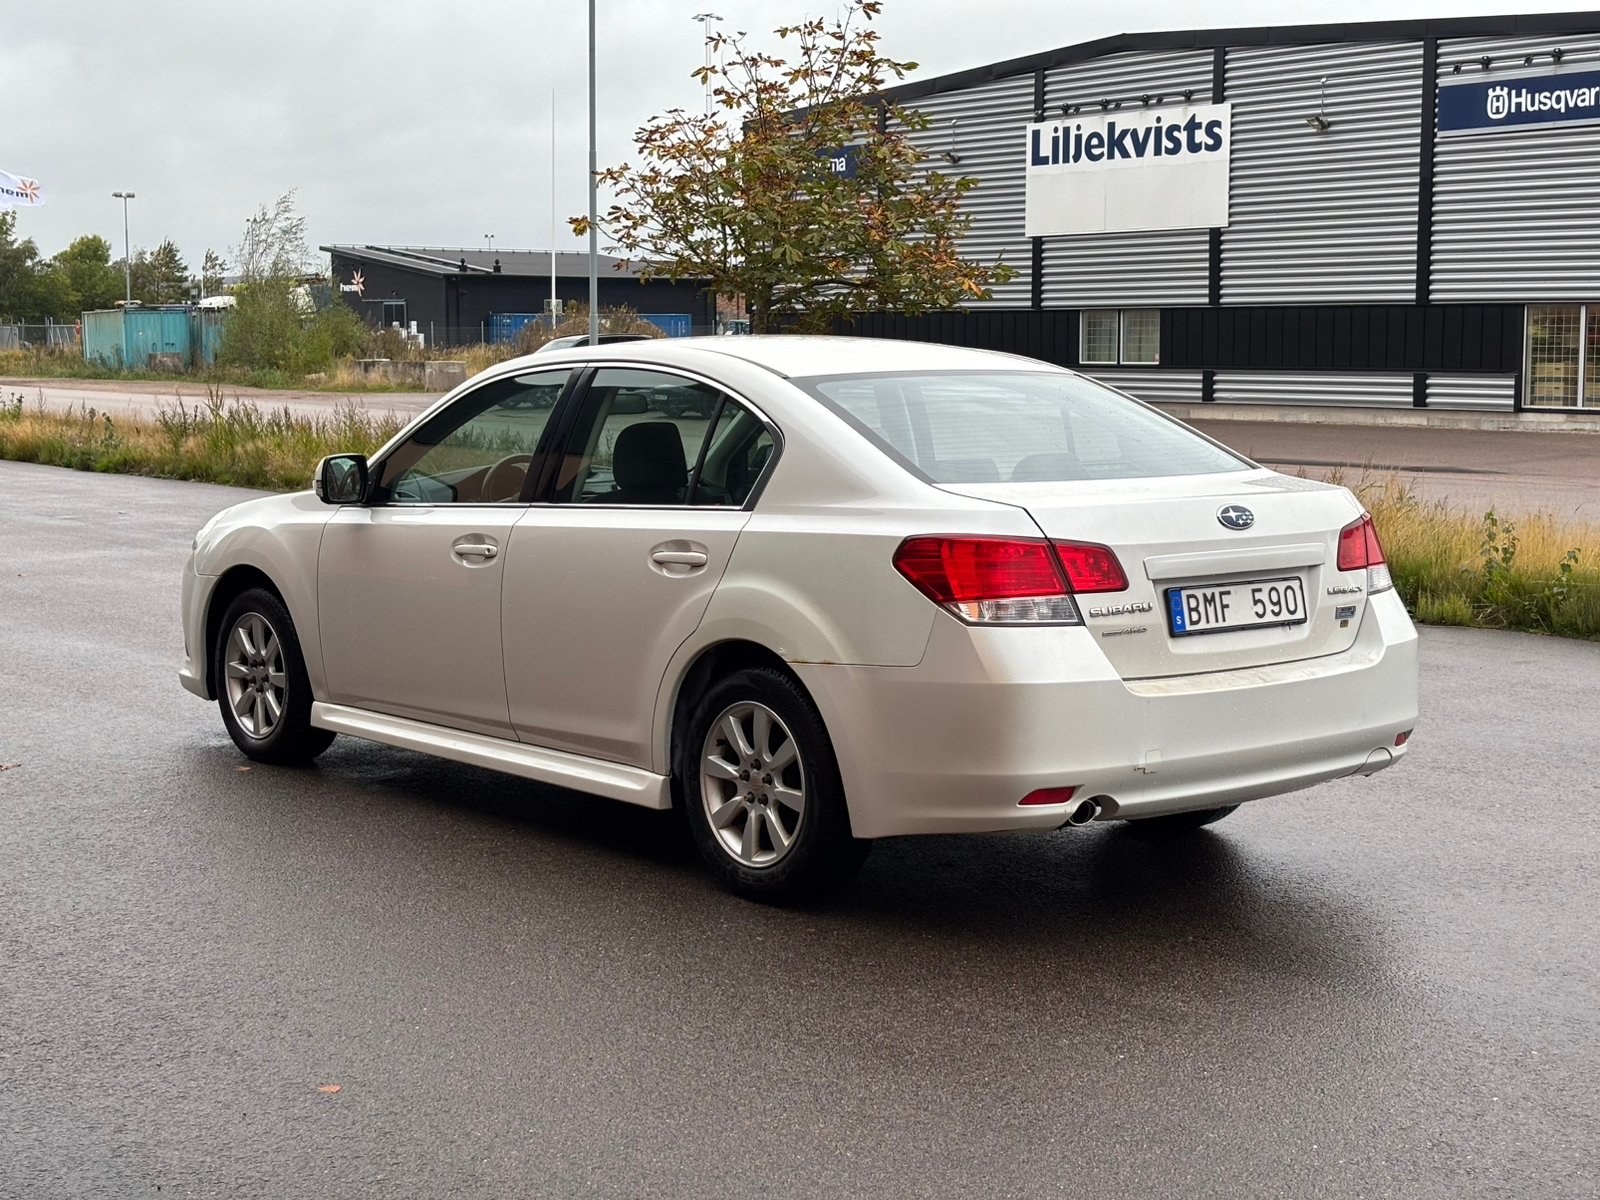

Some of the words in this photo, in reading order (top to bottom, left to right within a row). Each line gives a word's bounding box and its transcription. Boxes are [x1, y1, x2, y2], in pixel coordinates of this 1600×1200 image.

[1511, 86, 1600, 113] Husqvar
[1031, 113, 1223, 166] Liljekvists
[1326, 585, 1363, 595] LEGACY
[1089, 601, 1153, 617] SUBARU
[1176, 615, 1182, 625] S
[1186, 590, 1231, 626] BMF
[1251, 585, 1298, 619] 590
